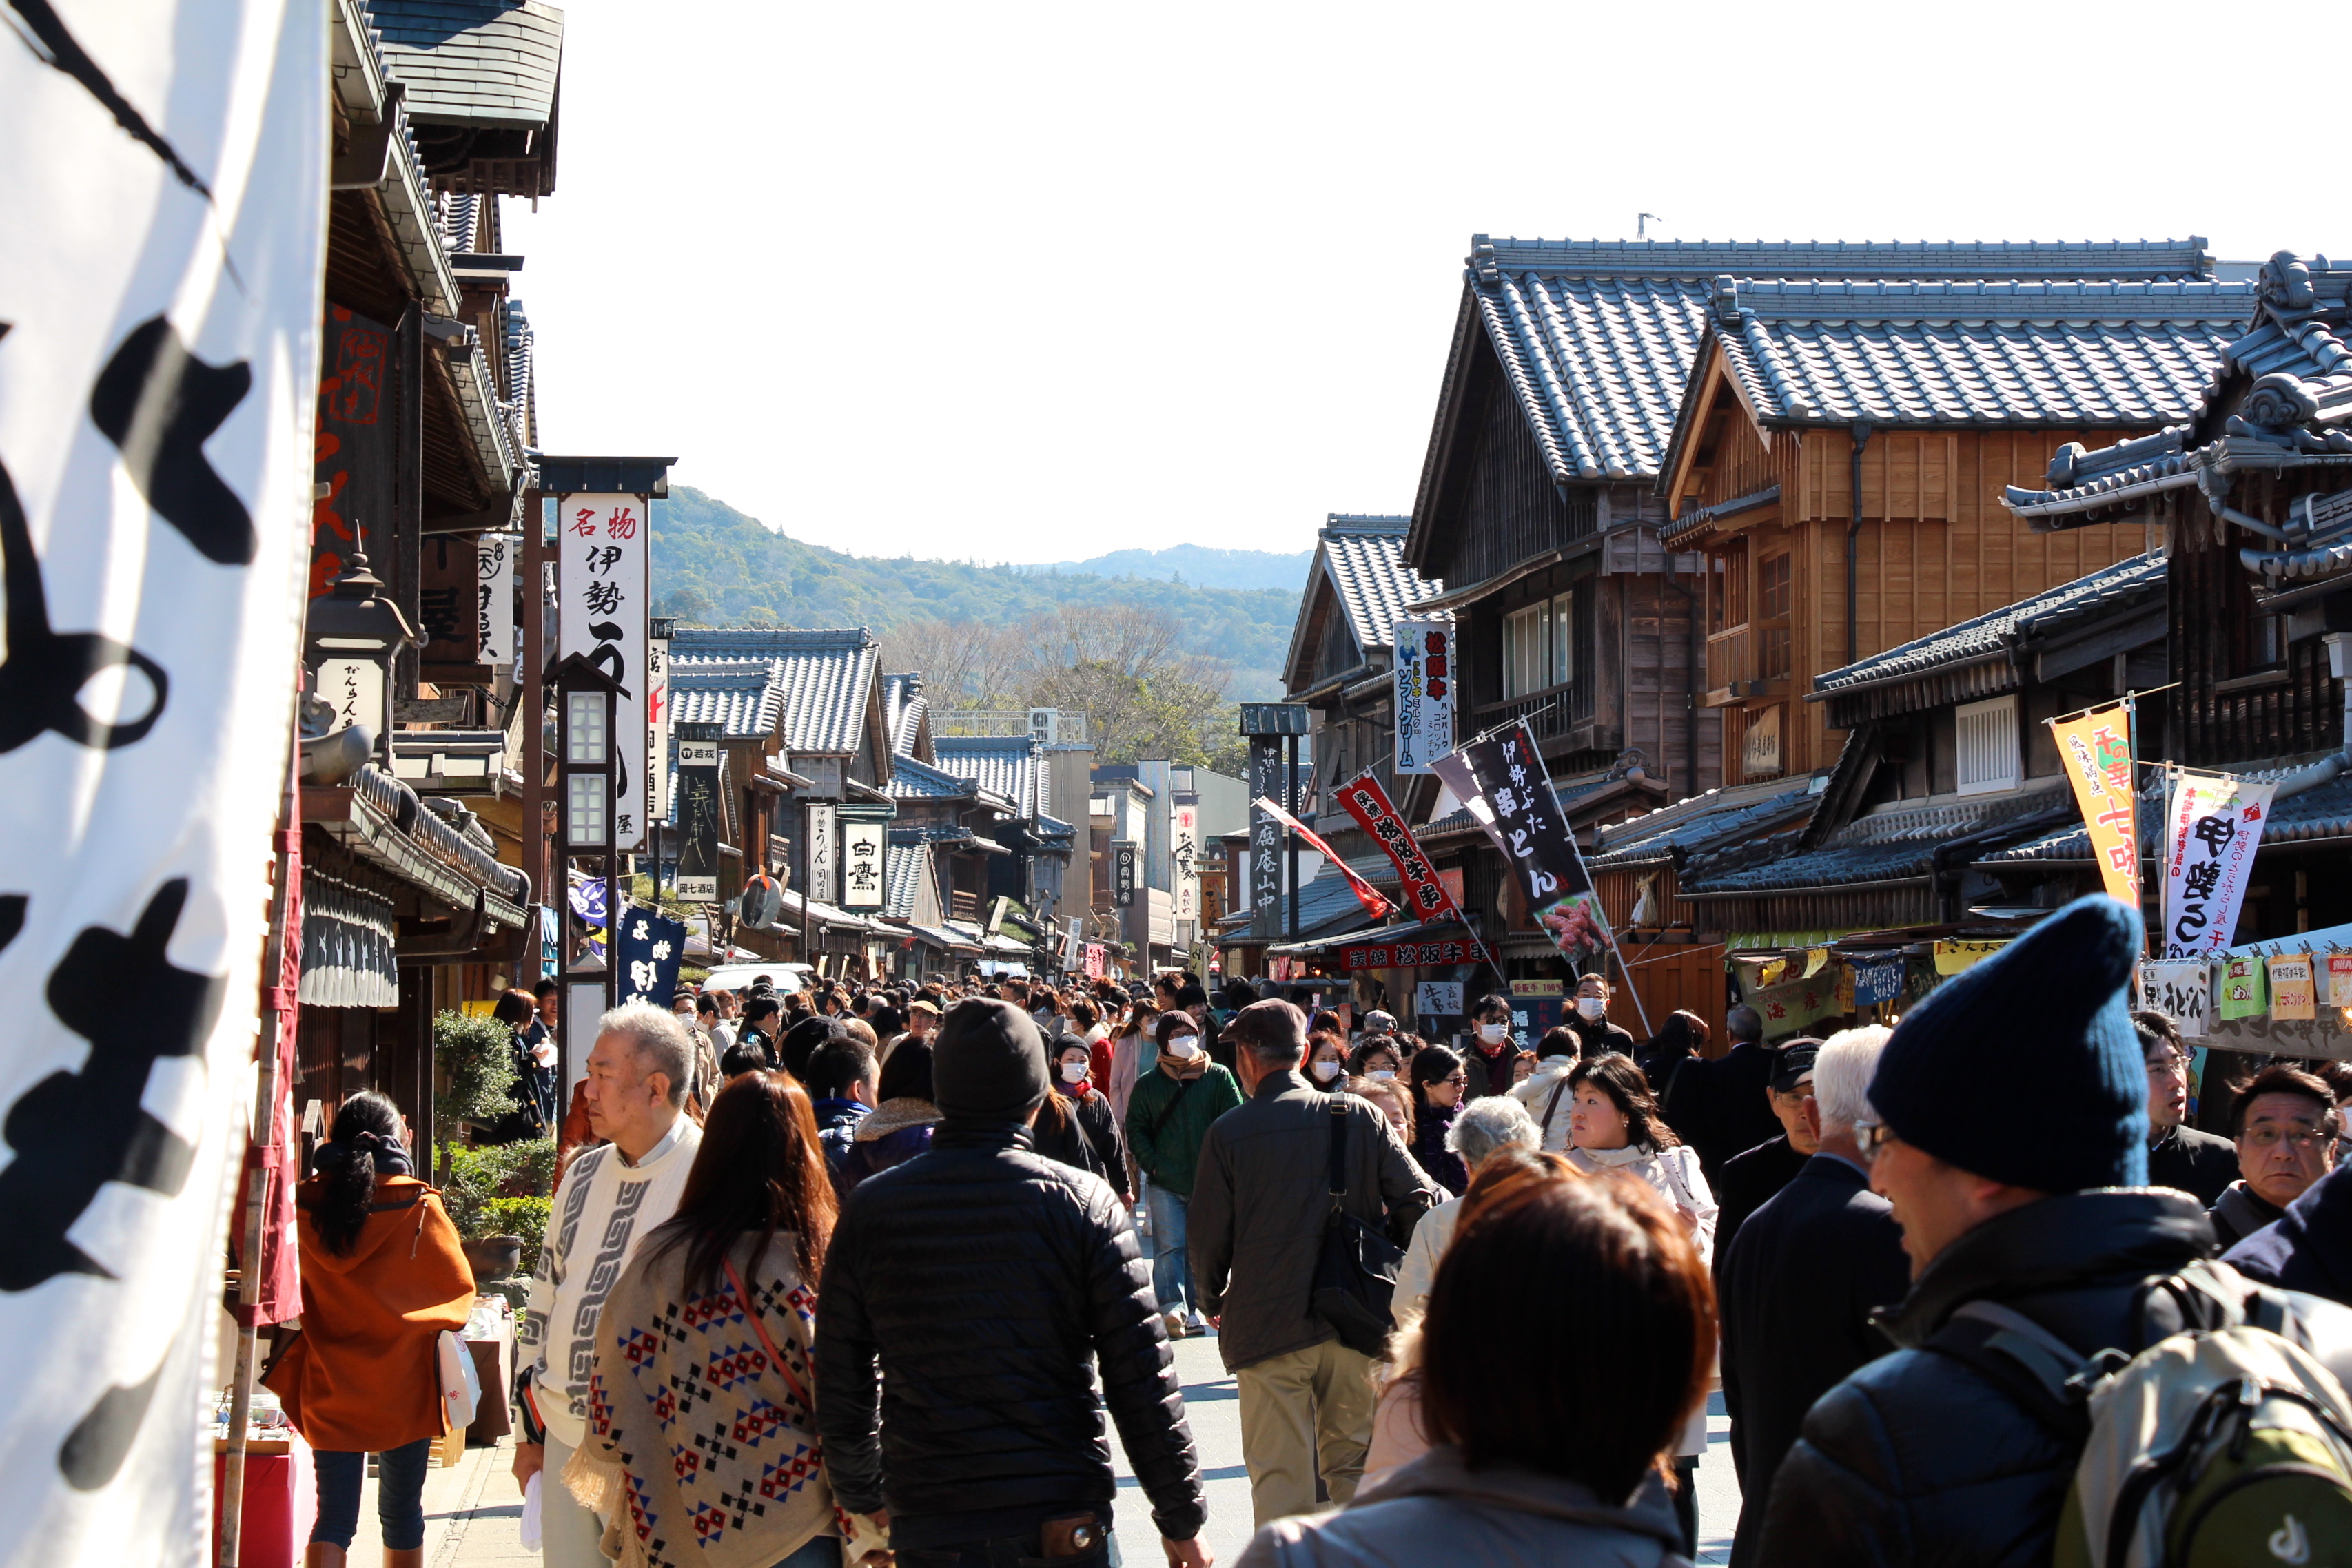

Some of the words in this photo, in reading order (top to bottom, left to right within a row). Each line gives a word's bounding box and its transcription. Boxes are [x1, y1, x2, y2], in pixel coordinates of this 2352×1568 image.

[569, 507, 636, 540] 名物
[1424, 630, 1447, 701] 松阪牛
[1398, 669, 1414, 767] ソフトクリーム
[693, 749, 715, 759] 若戎
[2068, 736, 2104, 796] 風味満点
[2094, 728, 2128, 787] 千の幸
[1502, 740, 1547, 835] 伊勢ぶた
[814, 809, 828, 864] 伊勢うどん
[1176, 832, 1196, 880] お食事処
[1373, 816, 1429, 883] 松阪牛
[679, 883, 715, 894] 岡七酒店
[848, 838, 879, 891] 白鷹
[1350, 949, 1387, 967] 炭焼
[1395, 943, 1464, 966] 松阪牛
[1513, 982, 1538, 993] 松阪牛
[1543, 982, 1563, 992] 100%
